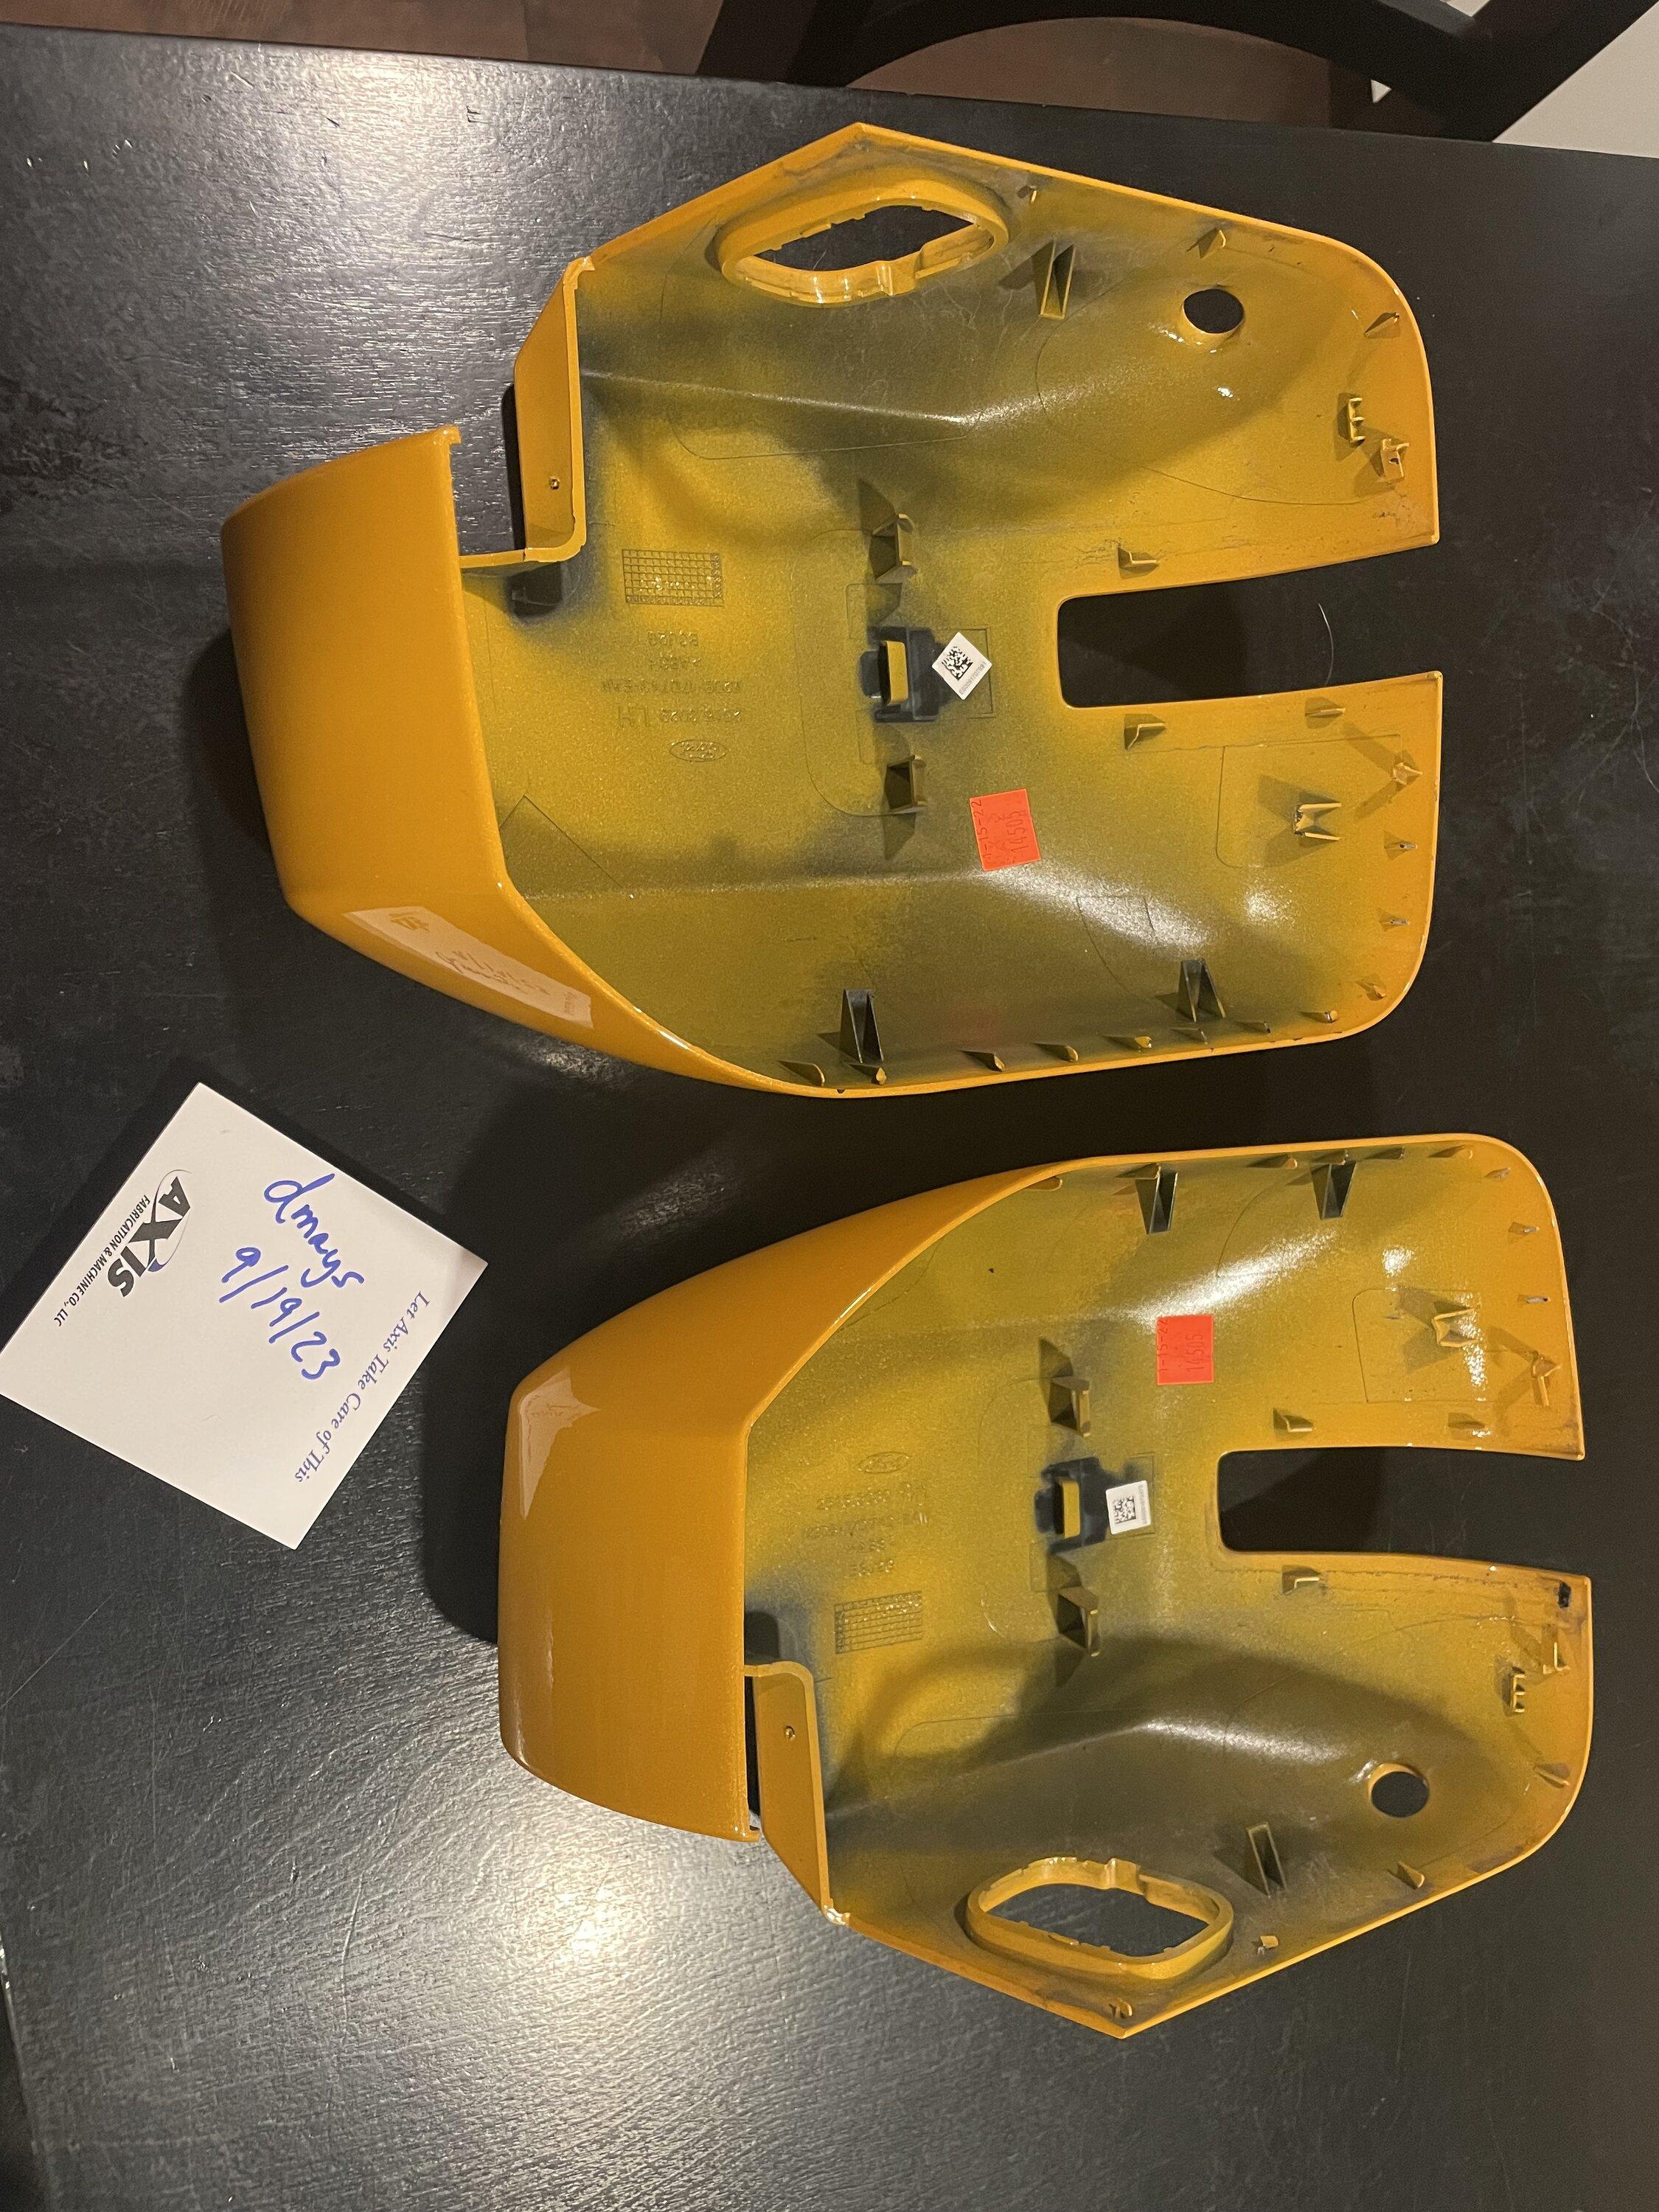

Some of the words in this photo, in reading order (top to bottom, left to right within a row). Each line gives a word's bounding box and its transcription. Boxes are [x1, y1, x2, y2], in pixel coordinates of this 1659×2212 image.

[108, 1175, 190, 1298] AXIS
[110, 1194, 150, 1251] FABRICATION
[264, 1173, 364, 1287] dmays
[103, 1247, 113, 1256] &
[77, 1255, 108, 1295] MACHINE
[54, 1308, 69, 1326] LLC
[64, 1293, 80, 1307] CO.,
[219, 1247, 340, 1380] 9/19/23
[406, 1291, 430, 1319] Let
[383, 1316, 409, 1352] Axis
[358, 1354, 389, 1390] Take
[331, 1393, 361, 1429] Care
[316, 1430, 332, 1455] of
[295, 1450, 324, 1482] This
